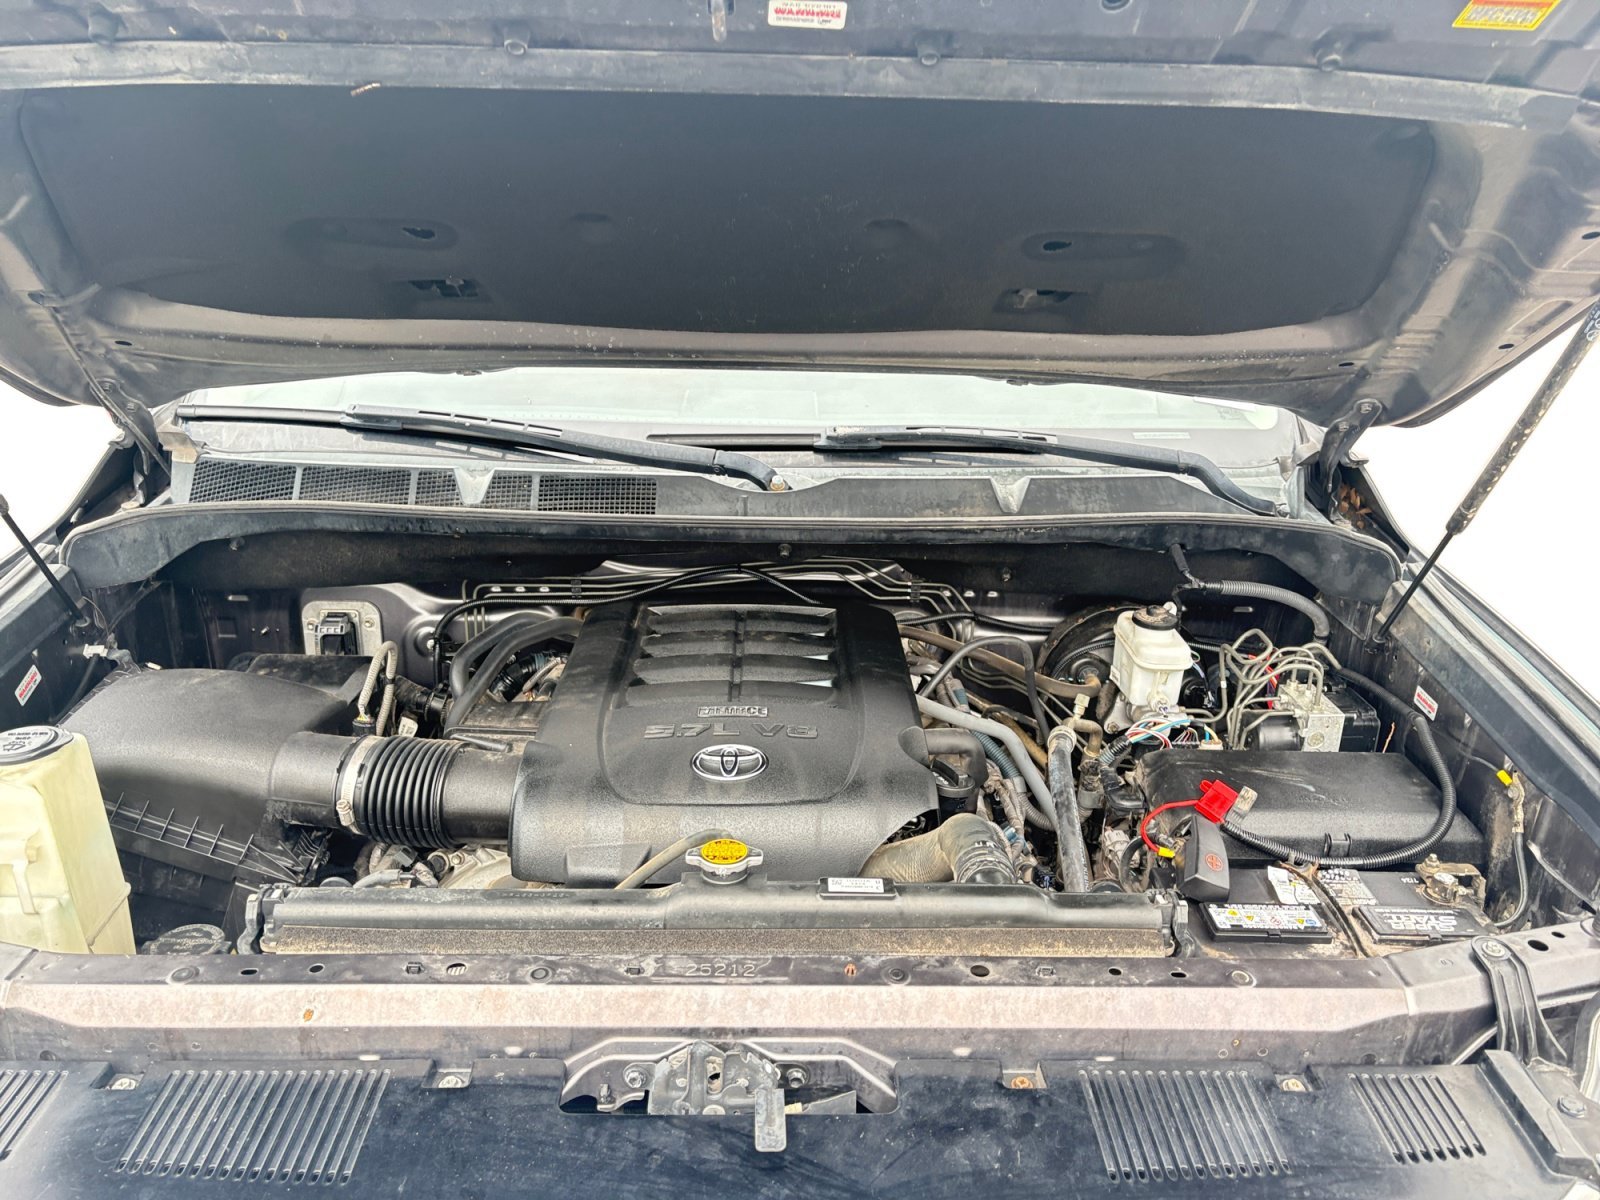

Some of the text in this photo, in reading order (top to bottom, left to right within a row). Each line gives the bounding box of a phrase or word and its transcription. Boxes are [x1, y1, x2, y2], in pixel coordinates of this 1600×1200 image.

[644, 722, 818, 739] 5.7L V8
[1389, 921, 1455, 932] SUPER
[685, 963, 755, 977] 25212
